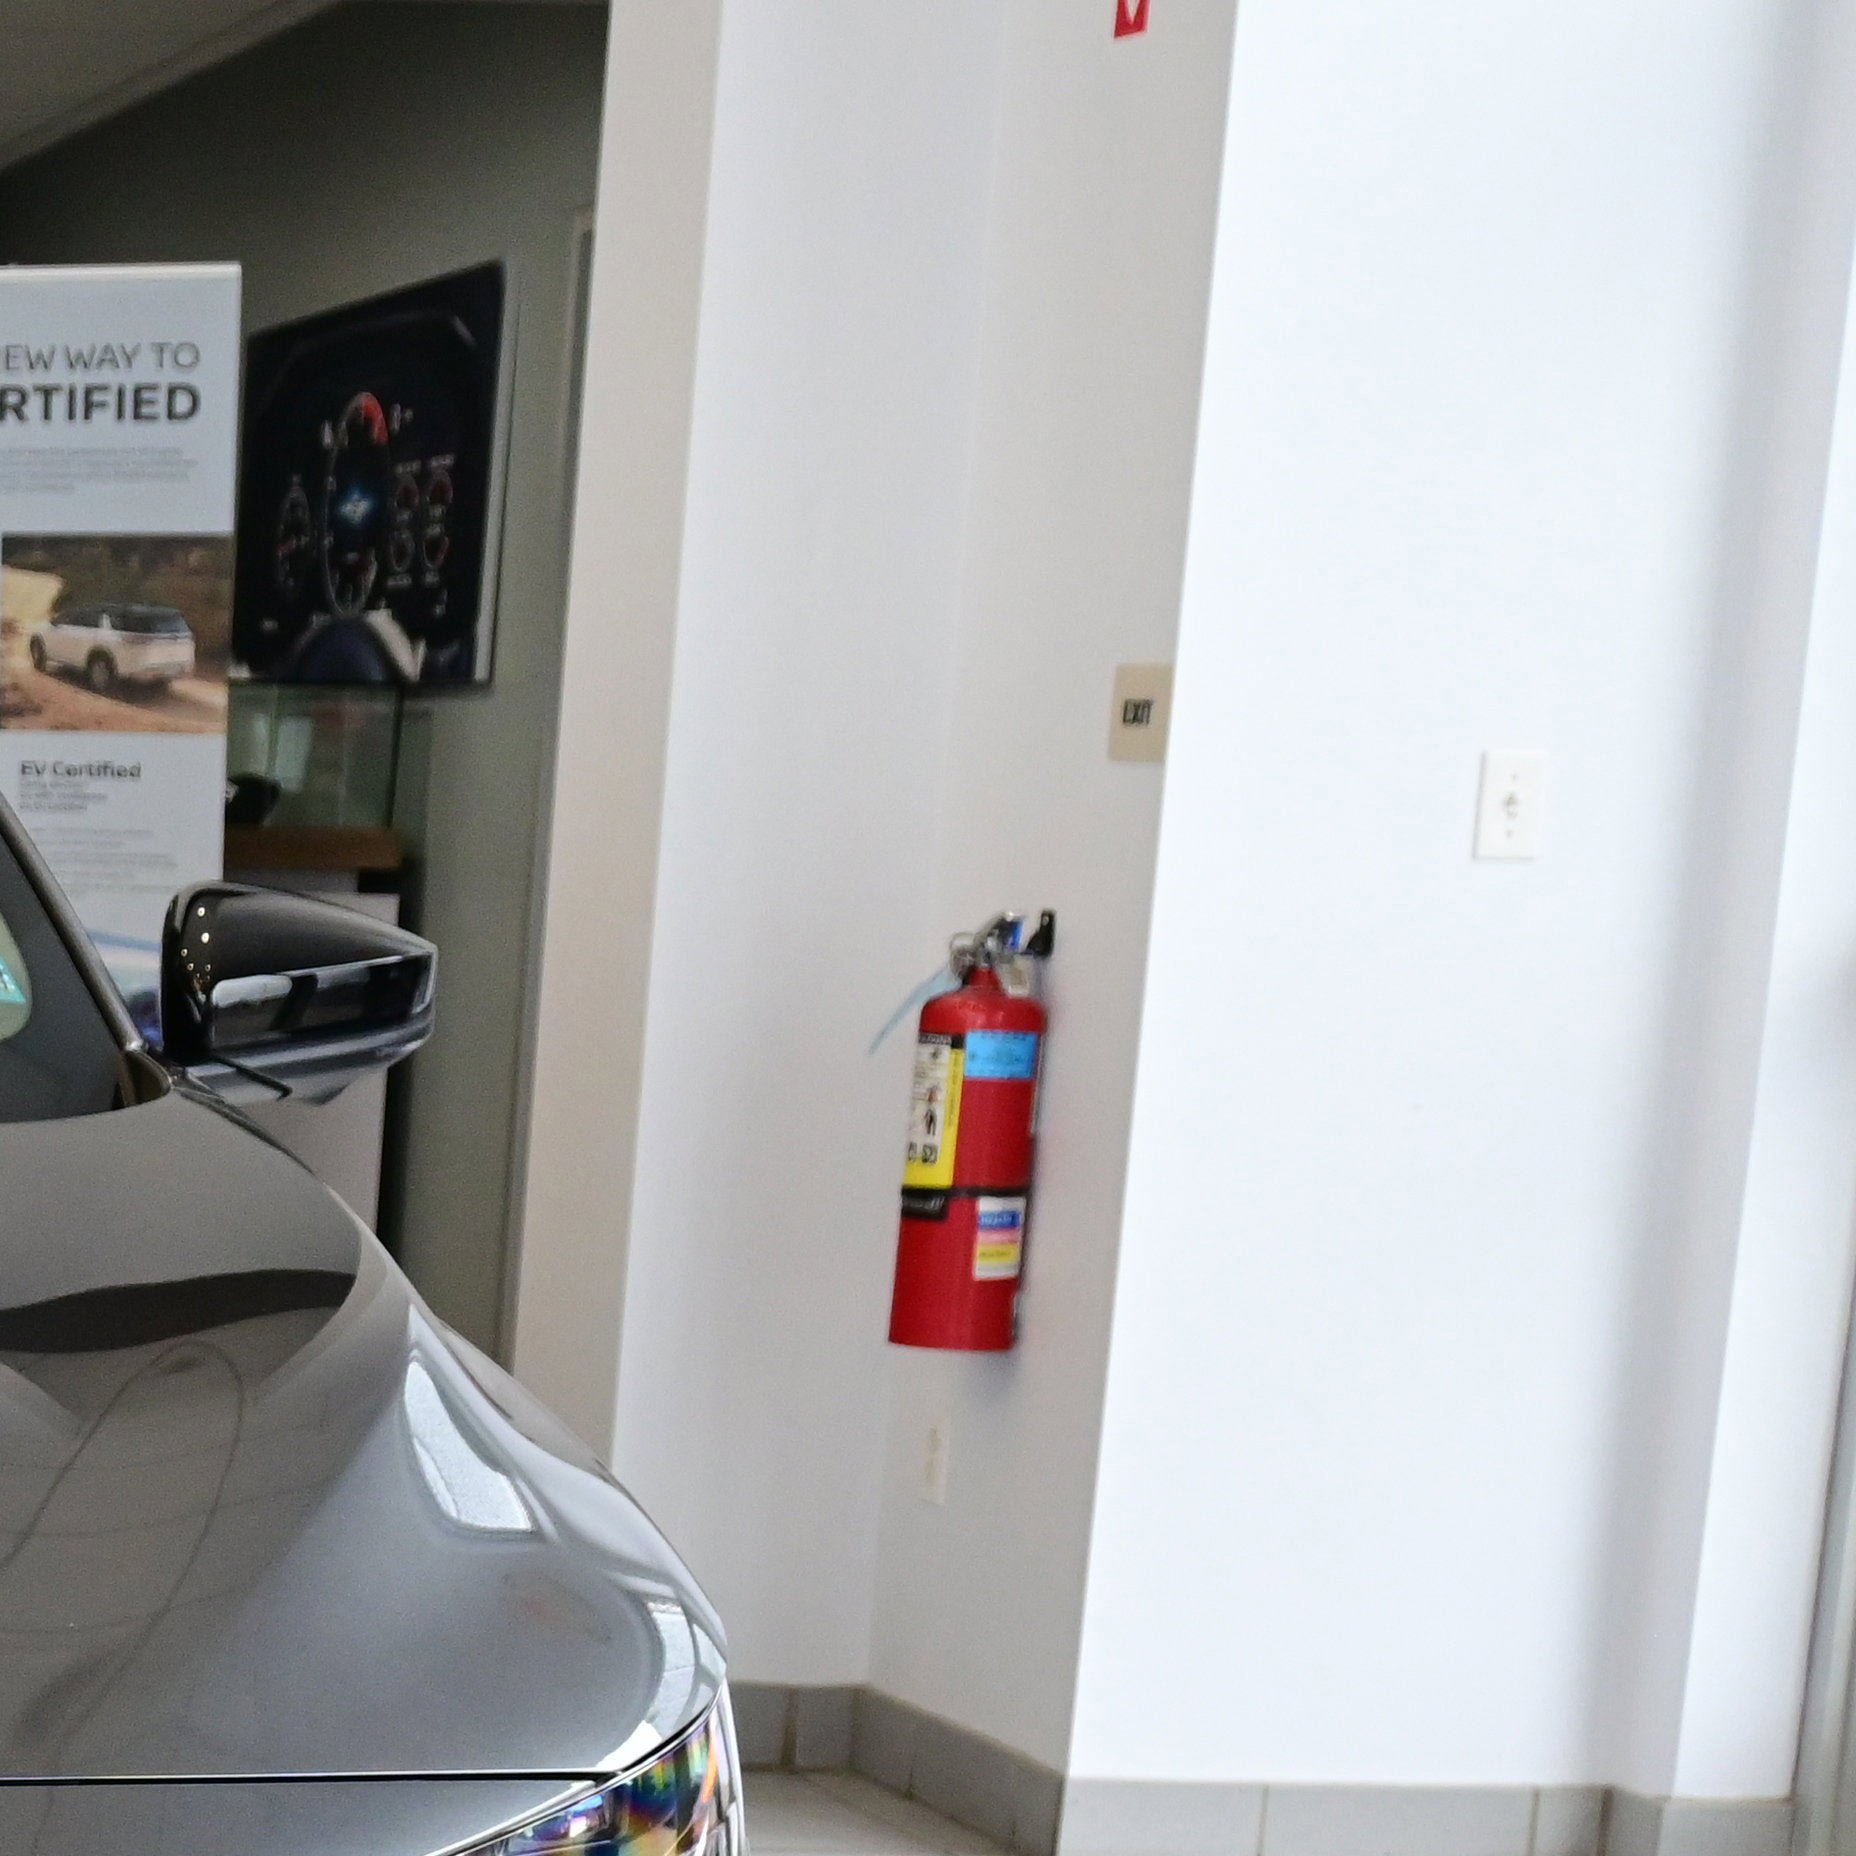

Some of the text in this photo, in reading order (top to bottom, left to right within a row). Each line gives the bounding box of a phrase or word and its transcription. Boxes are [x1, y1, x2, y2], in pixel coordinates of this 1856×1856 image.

[63, 341, 142, 372] WAY
[150, 341, 201, 370] TO
[1122, 698, 1154, 725] EXIT
[20, 760, 142, 778] EV Certified
